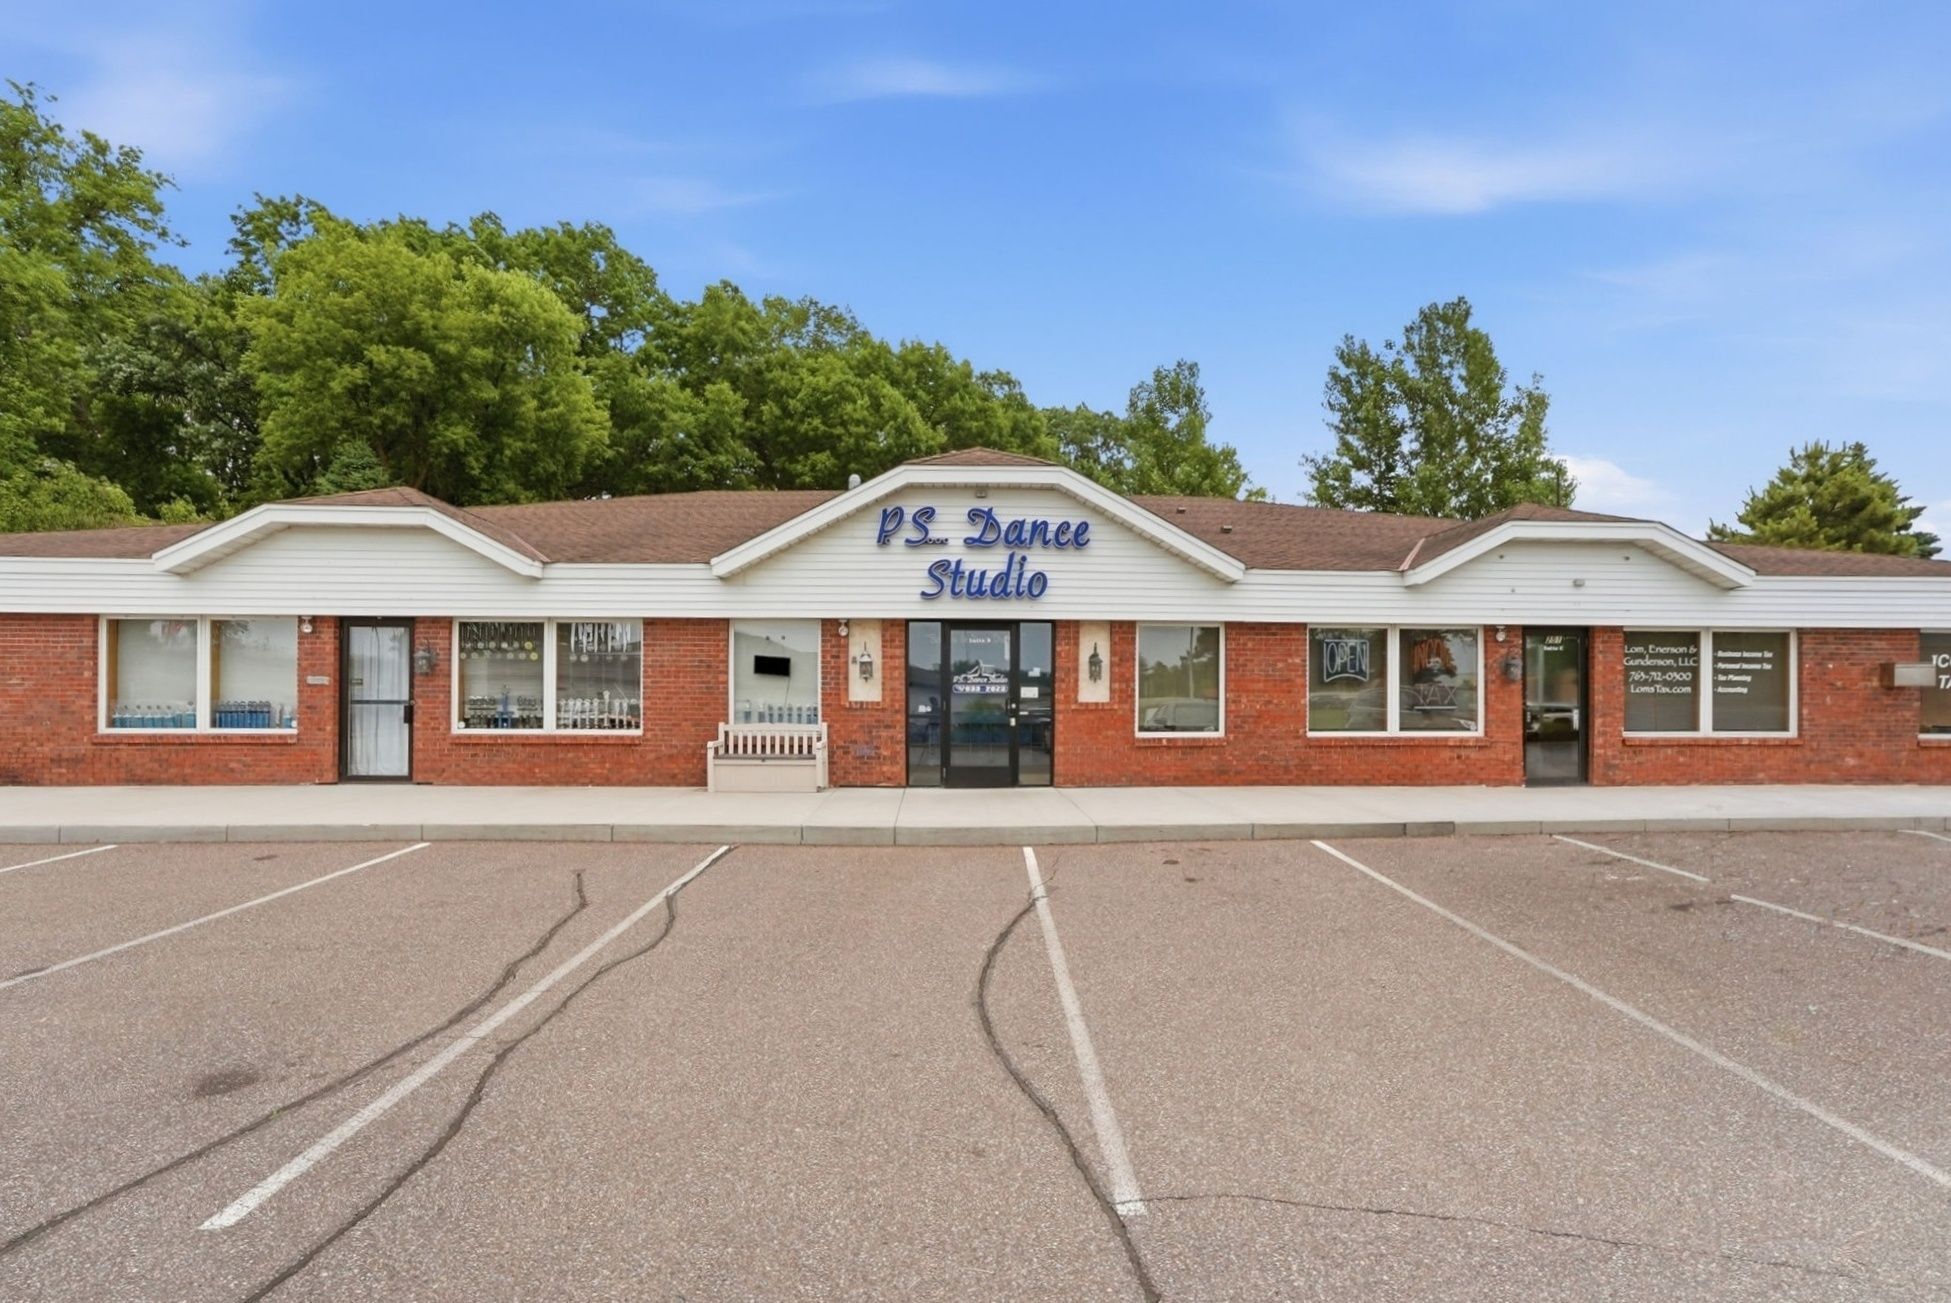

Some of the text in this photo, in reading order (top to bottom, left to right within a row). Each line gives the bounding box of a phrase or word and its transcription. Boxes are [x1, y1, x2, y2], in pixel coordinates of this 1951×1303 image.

[963, 507, 1091, 548] Dance
[920, 551, 1048, 599] Studio
[1326, 641, 1367, 674] OPEN
[1623, 654, 1698, 667] Gunderson, LLC
[1624, 645, 1647, 655] Lom,
[1648, 644, 1687, 654] Enerson
[1414, 683, 1457, 706] TAX
